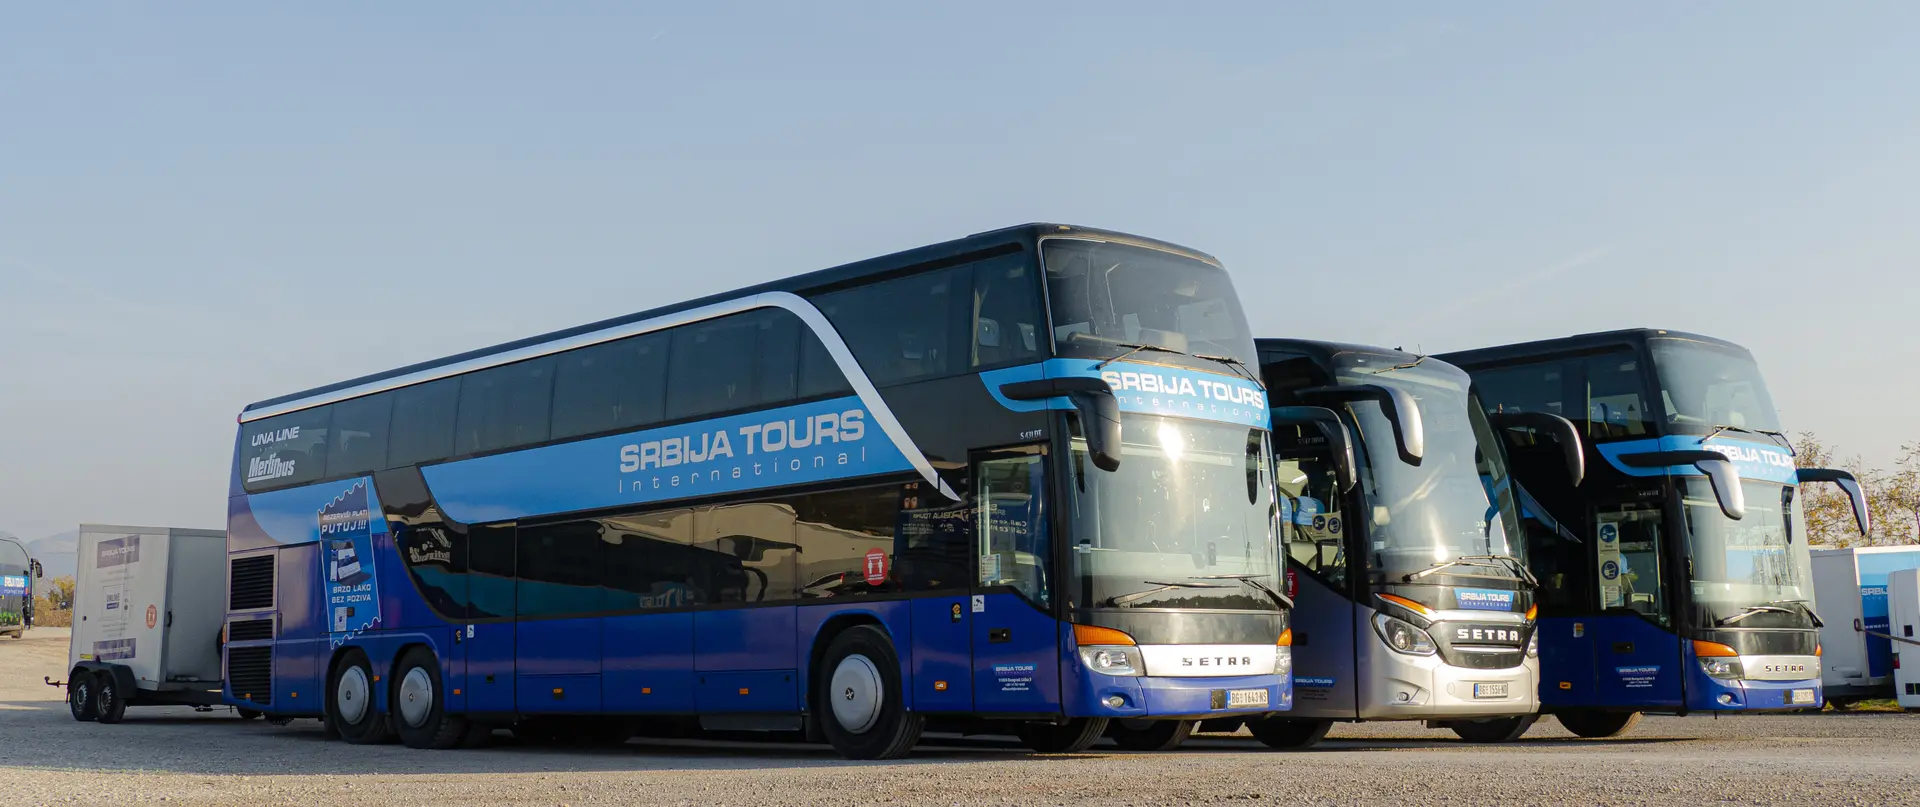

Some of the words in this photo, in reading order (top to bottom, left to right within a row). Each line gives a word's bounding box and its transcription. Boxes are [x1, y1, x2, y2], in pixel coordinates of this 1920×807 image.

[1100, 371, 1197, 398] SRBIJA
[1197, 379, 1264, 410] TOURS
[1118, 396, 1267, 424] nternational
[251, 432, 275, 447] UNA
[275, 425, 301, 442] LINE
[620, 430, 734, 473] SRBIJA
[740, 409, 865, 456] TOURS
[618, 445, 866, 494] International
[321, 519, 367, 535] PUTUJ!!!
[333, 585, 351, 594] BRZO
[353, 583, 372, 592] LAKO
[1861, 587, 1889, 596] SRBIJ
[331, 596, 345, 604] BEZ
[346, 593, 372, 603] POZIVA
[1460, 592, 1487, 601] SRBIJA
[1487, 593, 1510, 602] TOURS
[1457, 628, 1521, 641] SETRA
[1181, 656, 1251, 667] SETRA
[1765, 664, 1805, 672] SETRA
